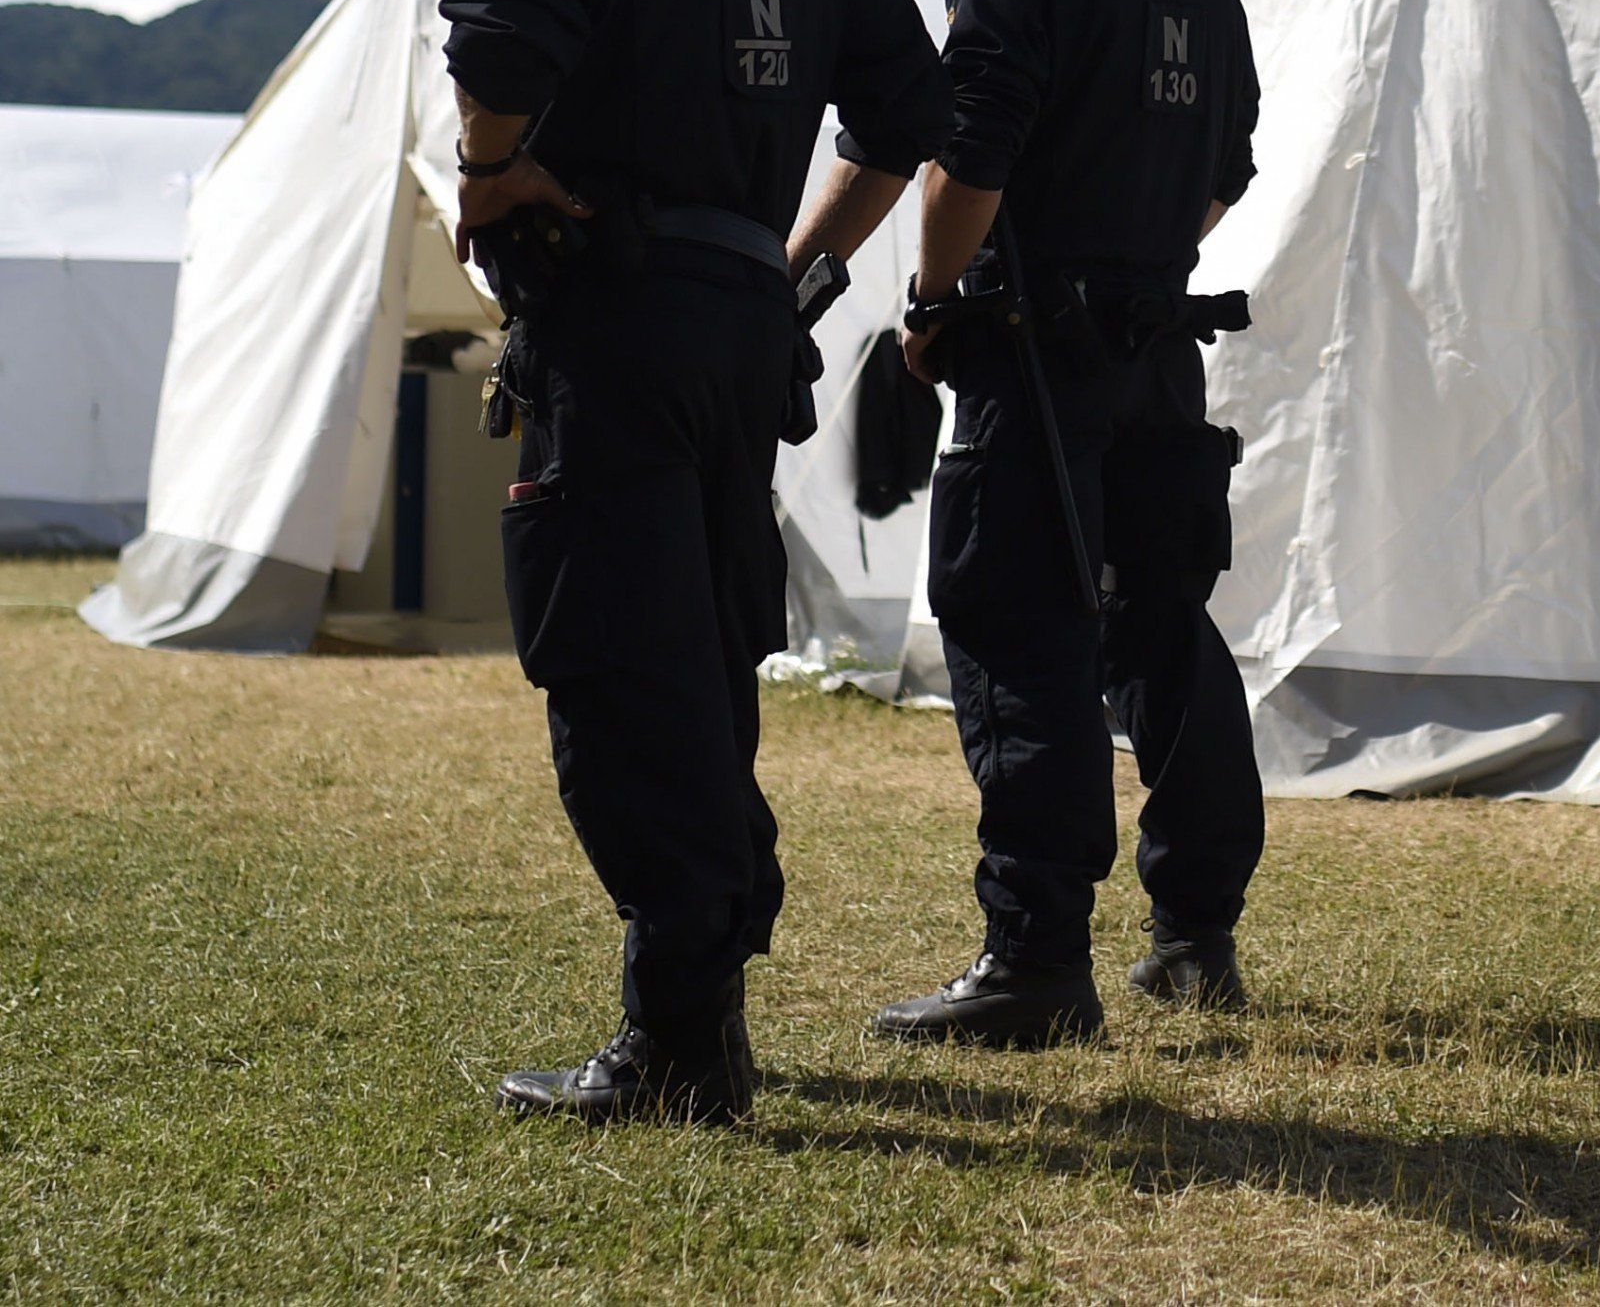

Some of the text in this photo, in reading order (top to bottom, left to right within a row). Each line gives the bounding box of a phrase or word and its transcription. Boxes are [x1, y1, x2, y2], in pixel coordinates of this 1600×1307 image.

[1163, 16, 1189, 65] N
[739, 50, 789, 87] 120
[1150, 68, 1198, 105] 130
